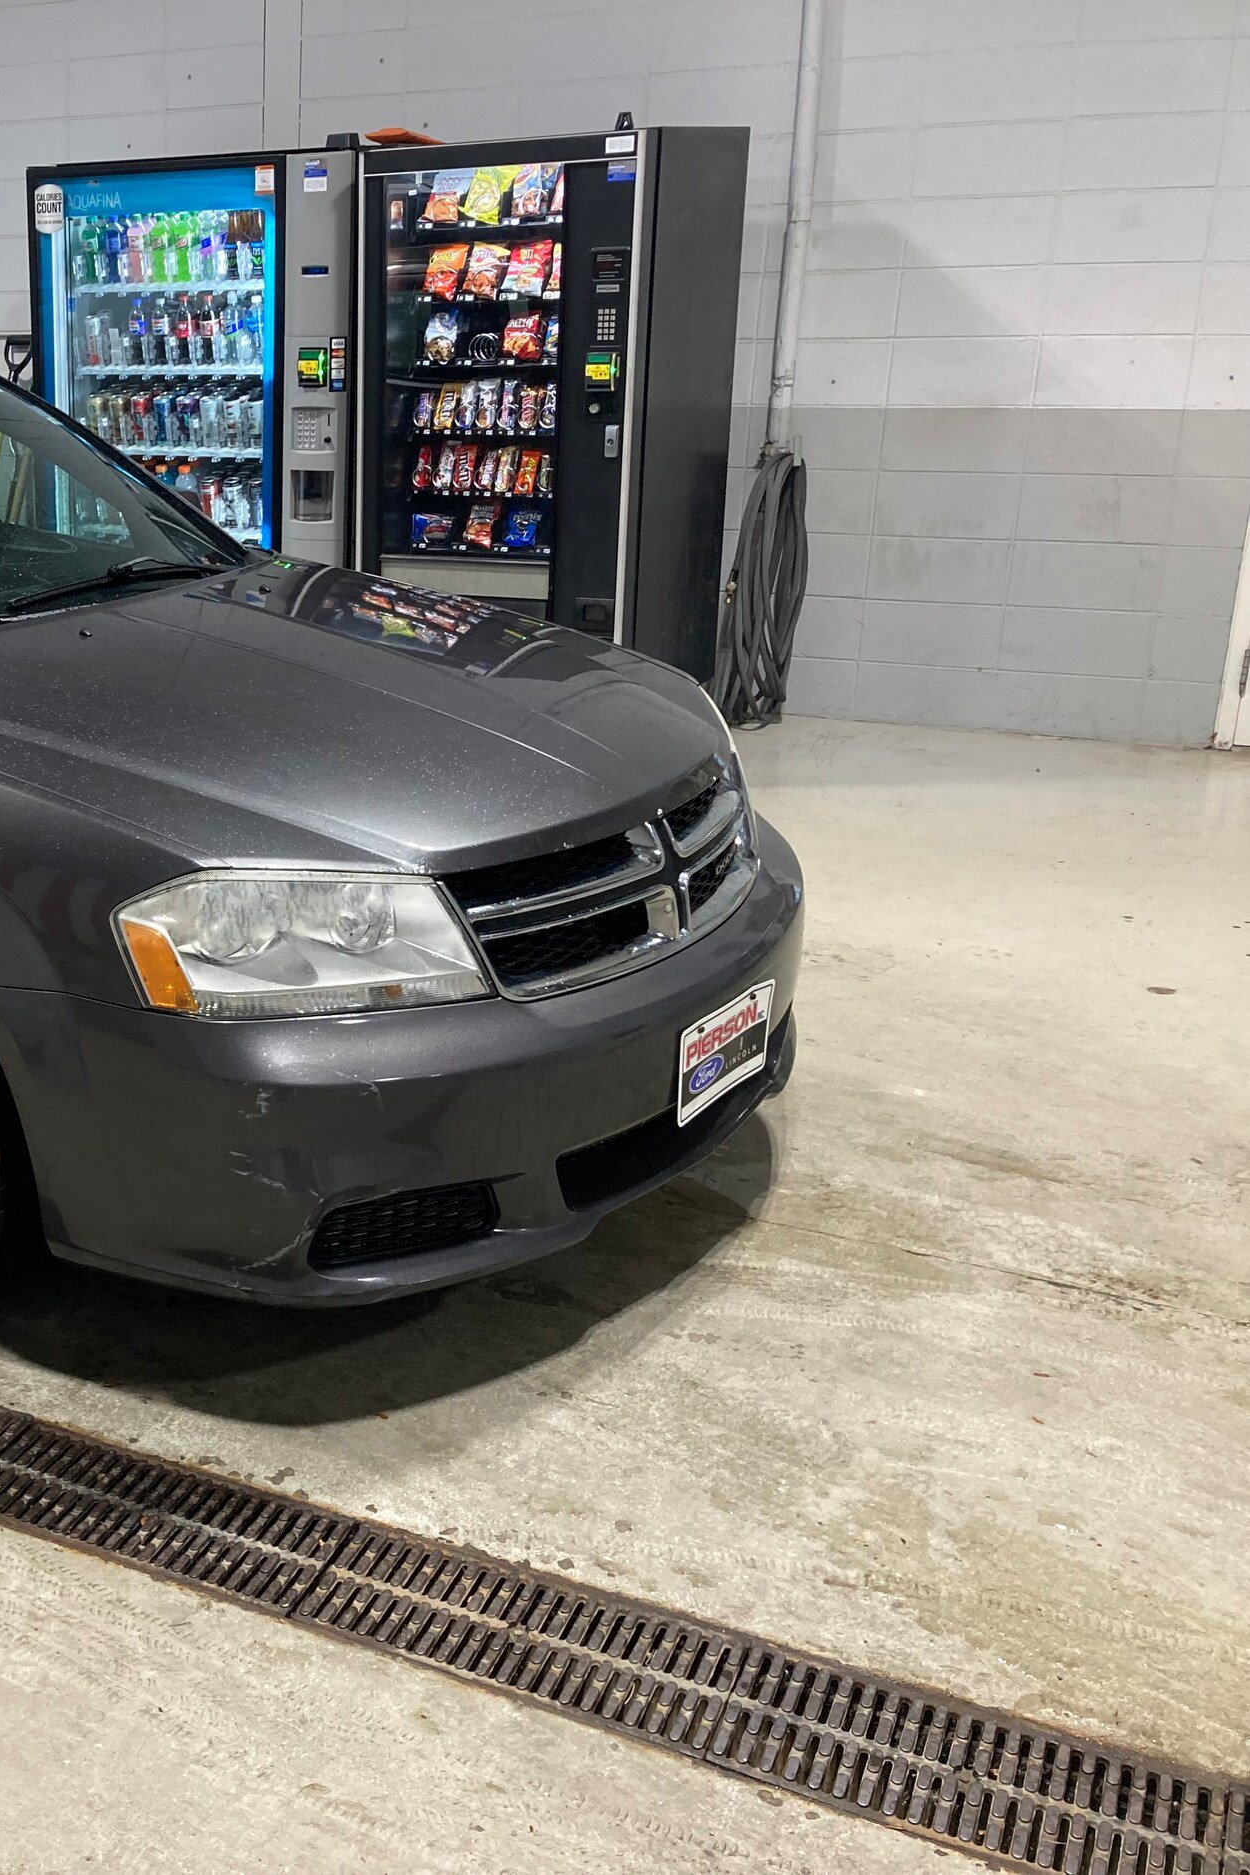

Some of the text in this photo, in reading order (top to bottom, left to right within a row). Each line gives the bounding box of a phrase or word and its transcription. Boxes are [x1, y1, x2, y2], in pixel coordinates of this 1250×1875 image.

[36, 193, 62, 202] CALORIES
[66, 191, 123, 211] AQUAFINA
[36, 202, 62, 214] COUNT
[725, 1043, 757, 1070] LINCOLN
[695, 1060, 718, 1088] Ford
